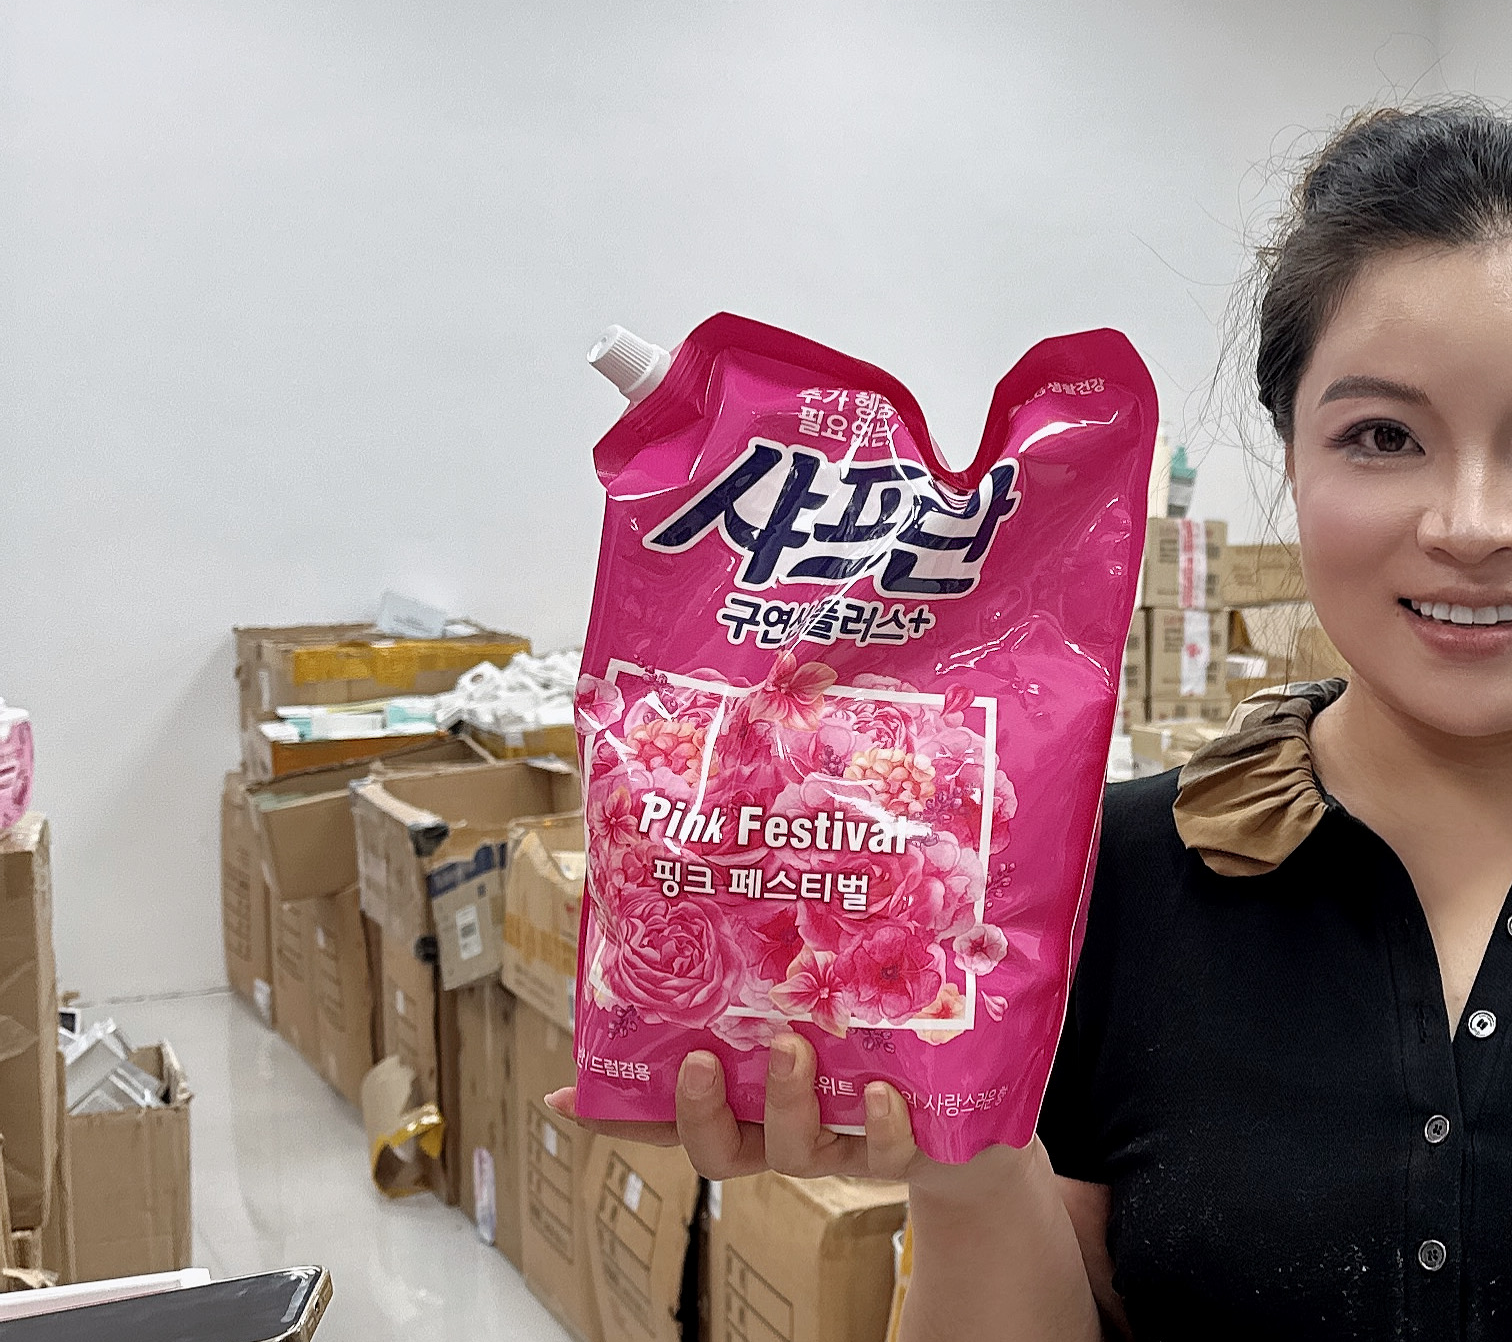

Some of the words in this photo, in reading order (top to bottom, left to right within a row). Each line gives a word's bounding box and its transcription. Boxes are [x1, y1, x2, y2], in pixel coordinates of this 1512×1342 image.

[796, 387, 850, 412] 추가
[638, 790, 728, 845] Pink
[737, 806, 909, 855] Festival
[652, 858, 716, 898] 핑크
[728, 868, 870, 912] 페스티벌
[814, 1075, 858, 1097] 위트
